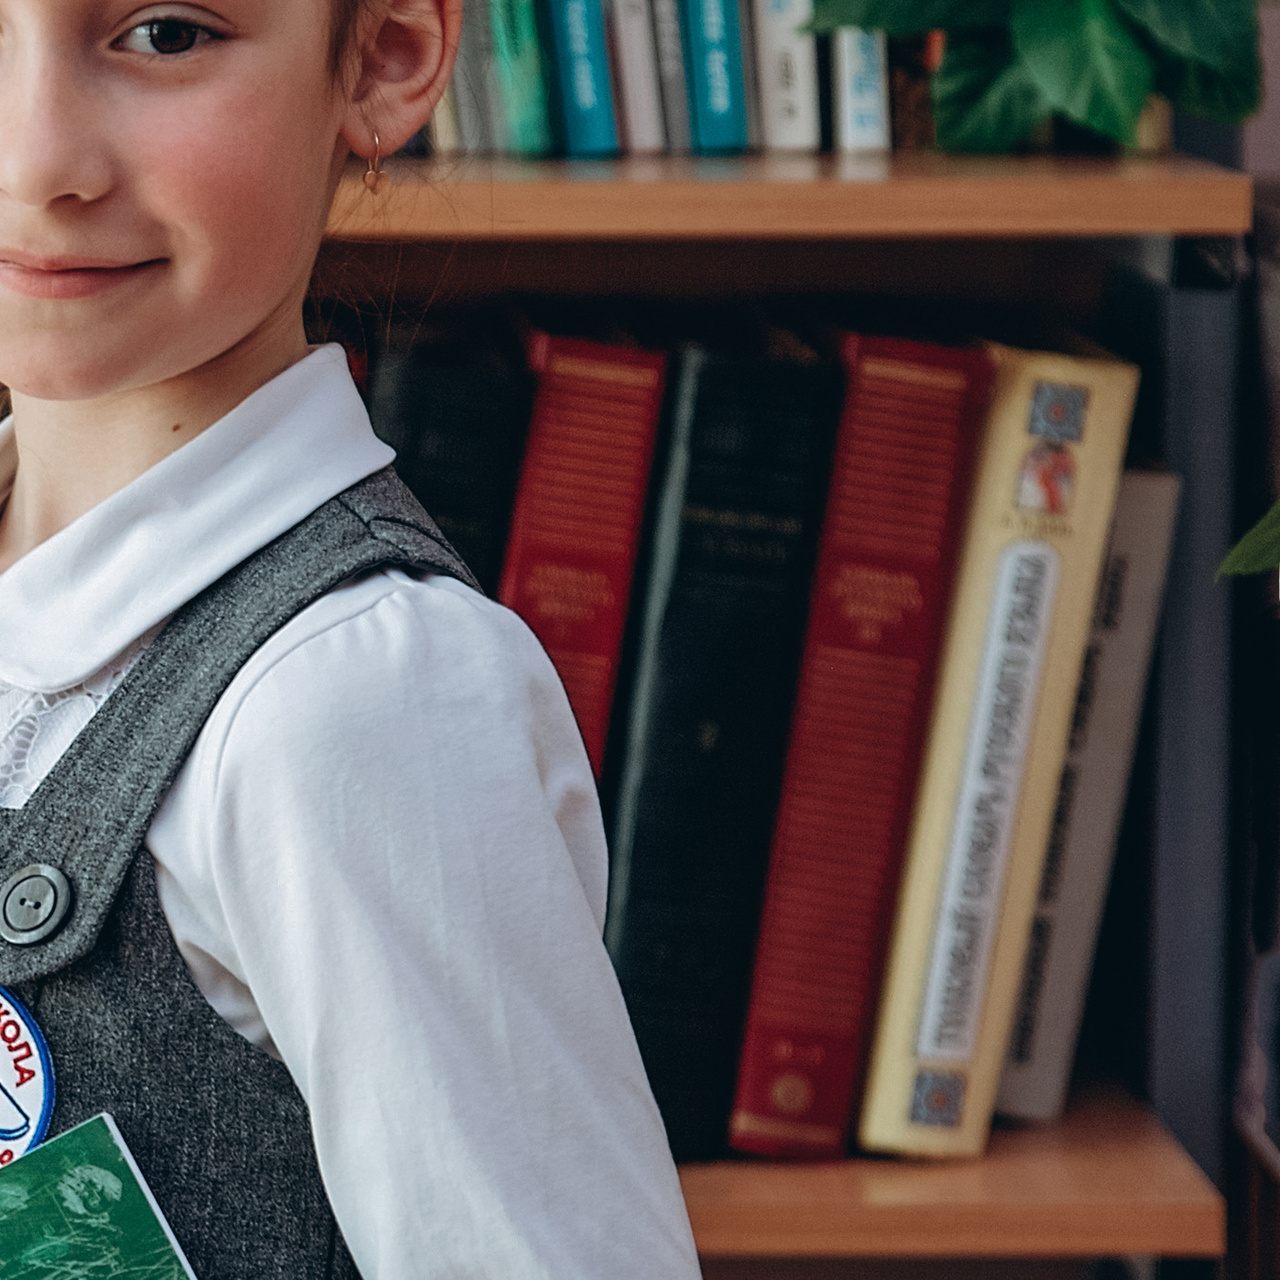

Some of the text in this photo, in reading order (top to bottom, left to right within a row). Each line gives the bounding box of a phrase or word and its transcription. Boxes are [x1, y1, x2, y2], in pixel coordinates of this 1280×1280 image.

[975, 654, 1032, 784] РУССКОГО
[962, 785, 1013, 904] СЛОВАРЬ
[921, 905, 990, 1052] ТОЛКОВЫЙ
